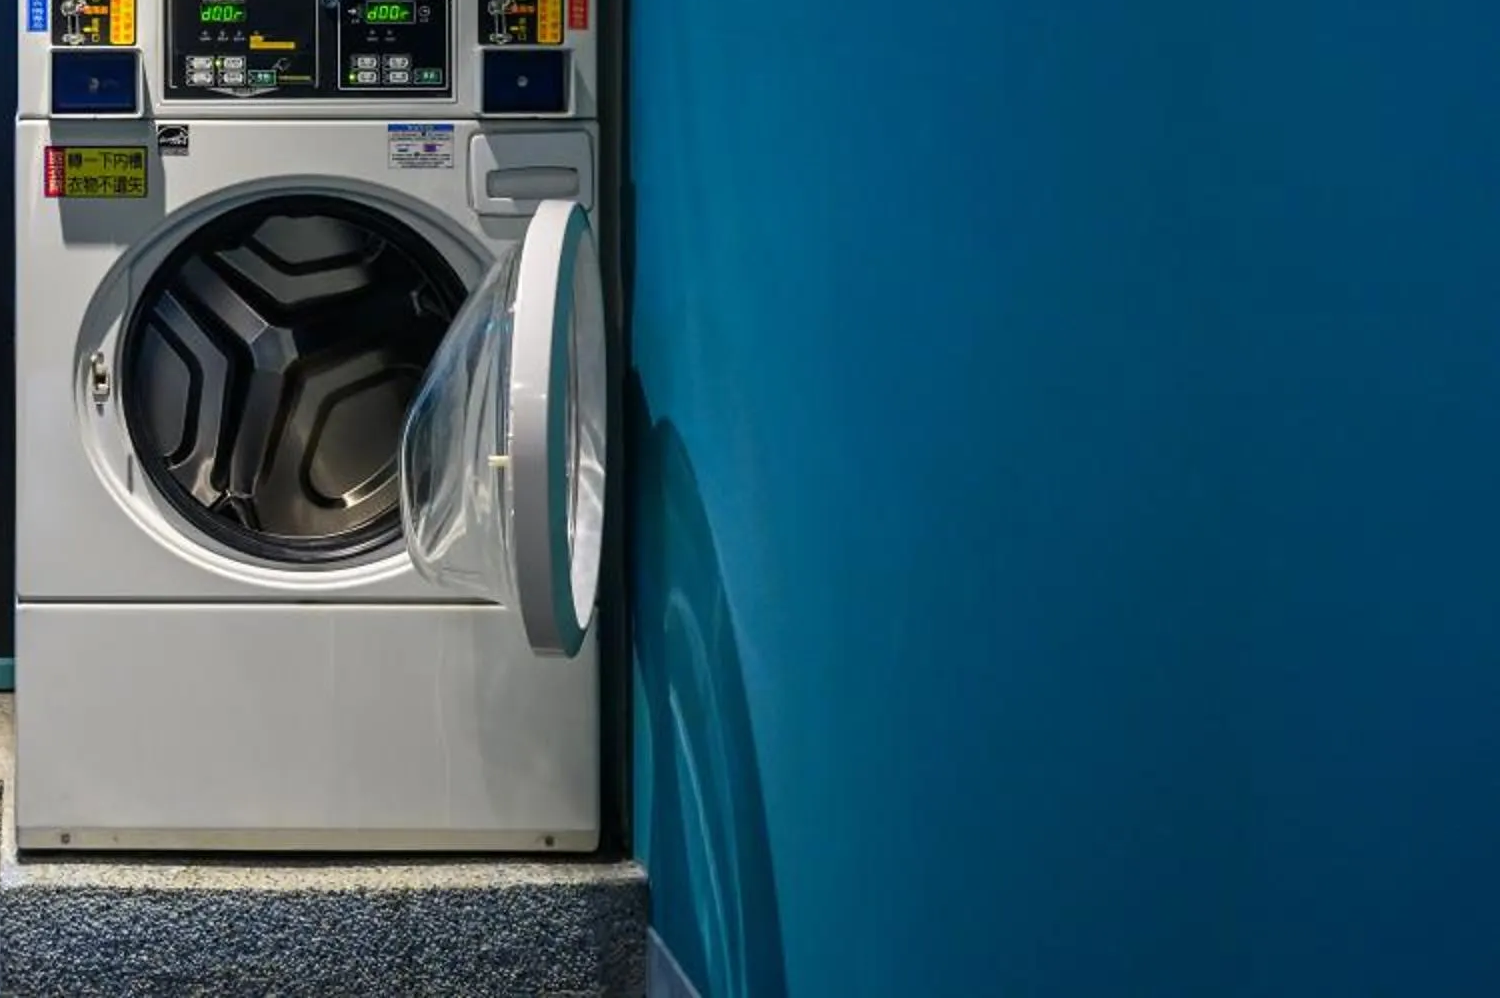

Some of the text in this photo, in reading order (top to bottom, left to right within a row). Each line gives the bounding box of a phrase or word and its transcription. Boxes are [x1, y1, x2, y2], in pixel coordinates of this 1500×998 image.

[67, 175, 143, 195] 衣物不遺失
